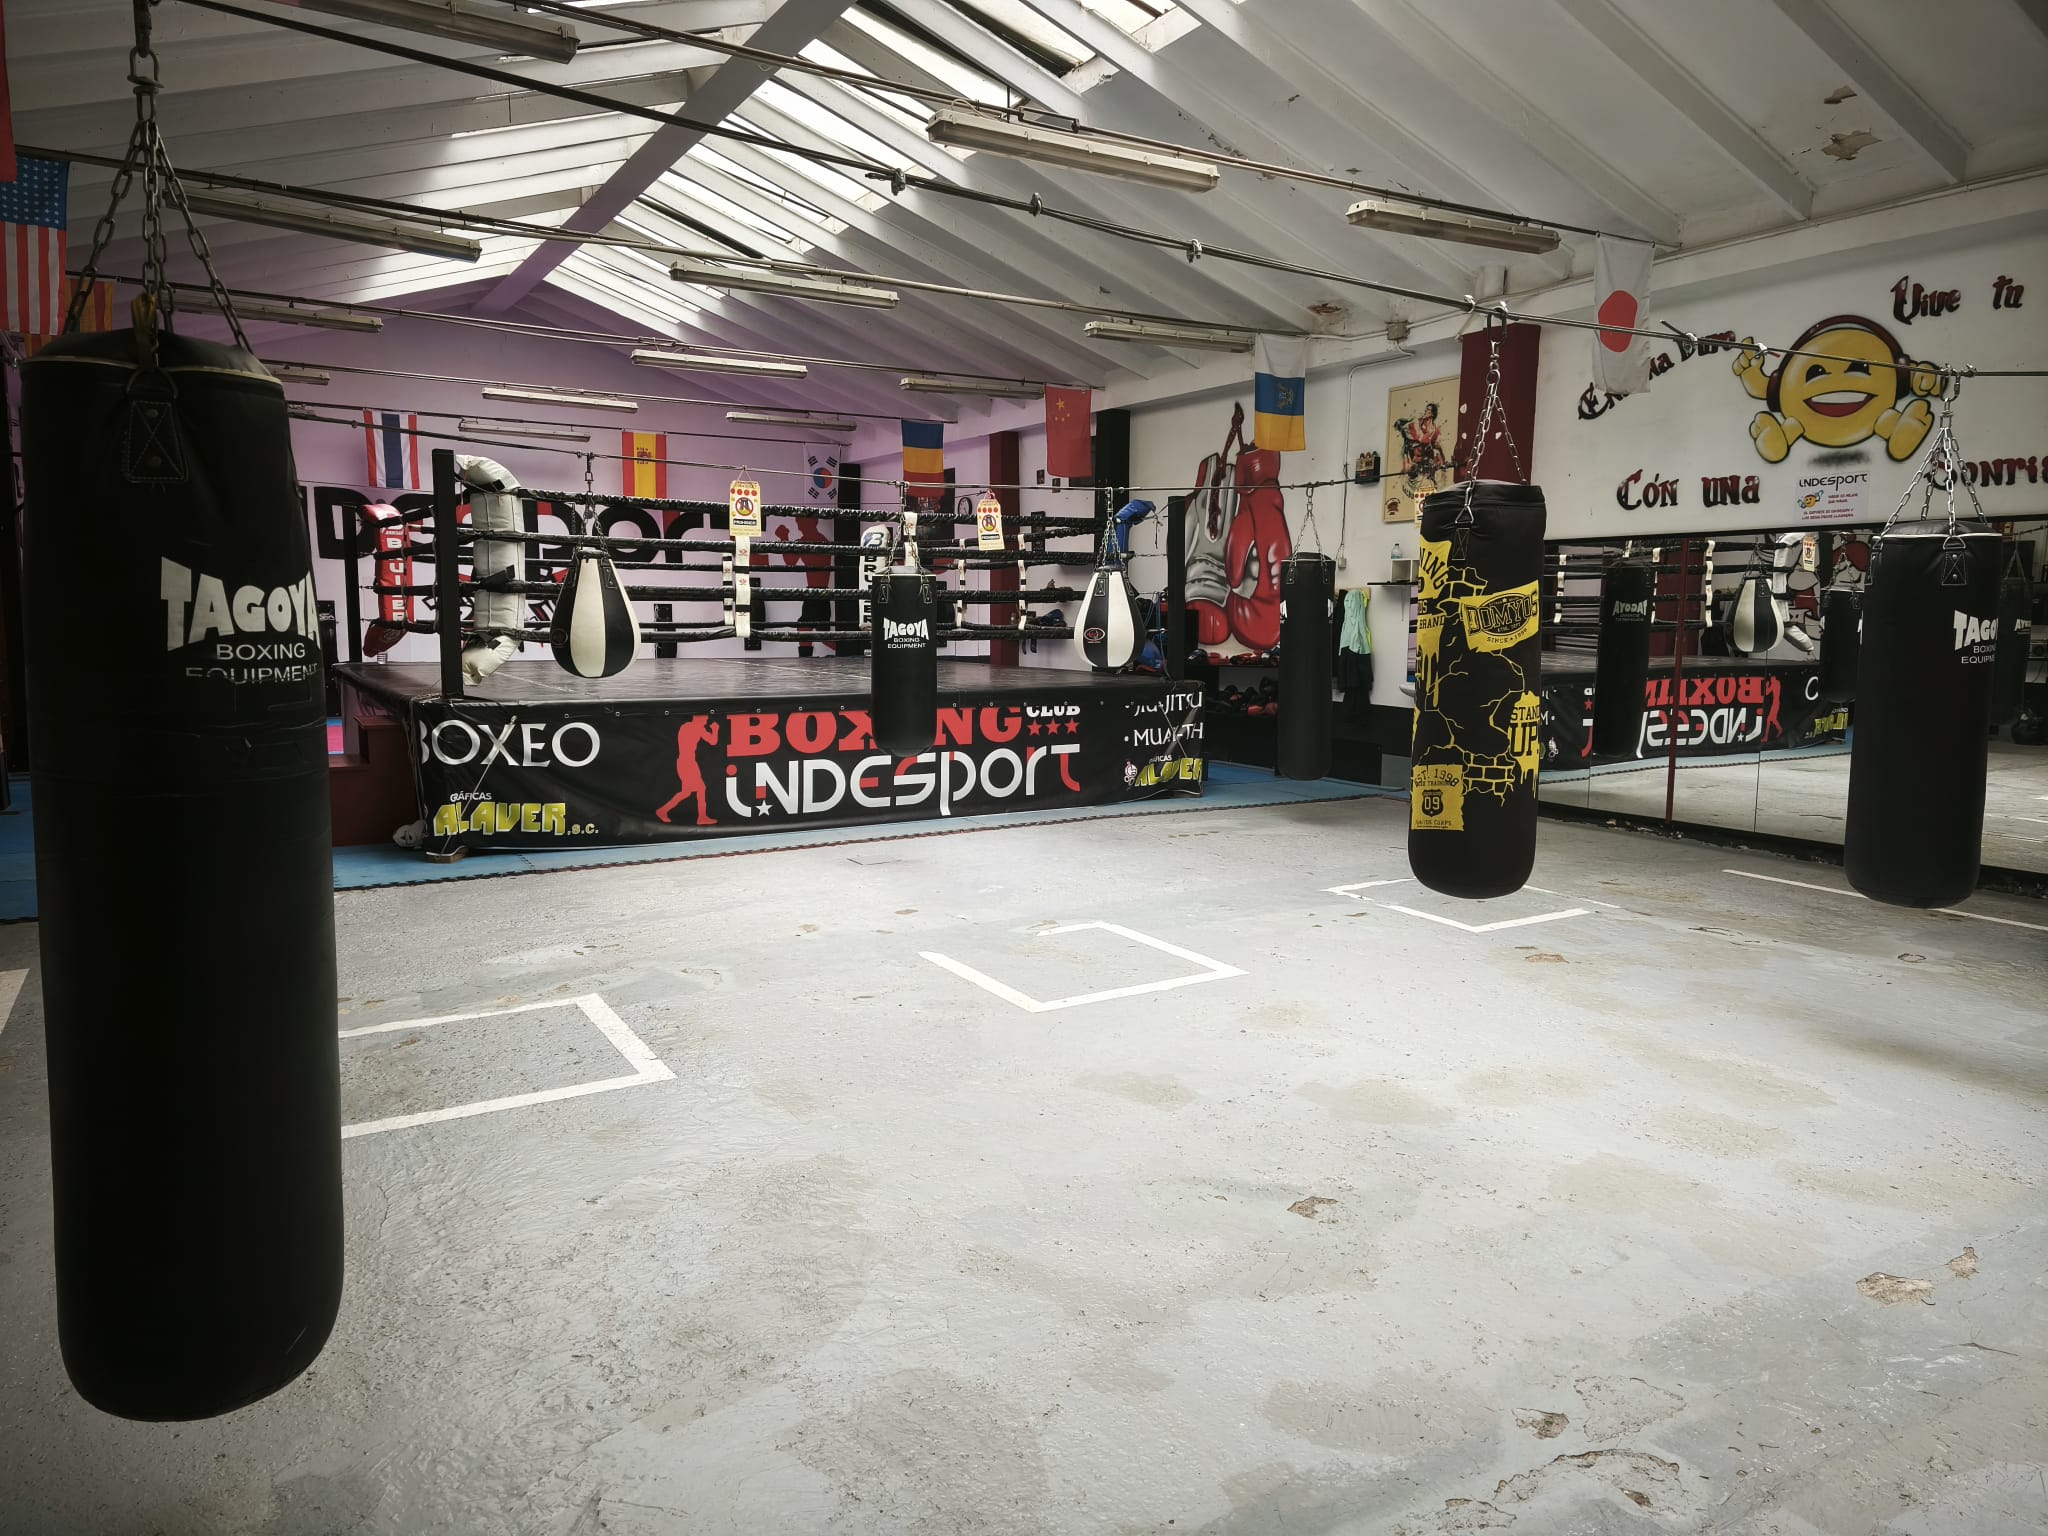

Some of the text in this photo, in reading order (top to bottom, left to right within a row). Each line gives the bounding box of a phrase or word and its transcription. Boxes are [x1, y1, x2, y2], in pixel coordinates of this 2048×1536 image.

[161, 556, 321, 650] TAGOYA
[1464, 591, 1538, 636] DOMYOS
[883, 617, 930, 641] TAGOYA
[216, 642, 306, 661] BOXING
[727, 704, 1022, 757] BOXNG
[1434, 767, 1460, 787] 1998
[1424, 796, 1440, 810] 09
